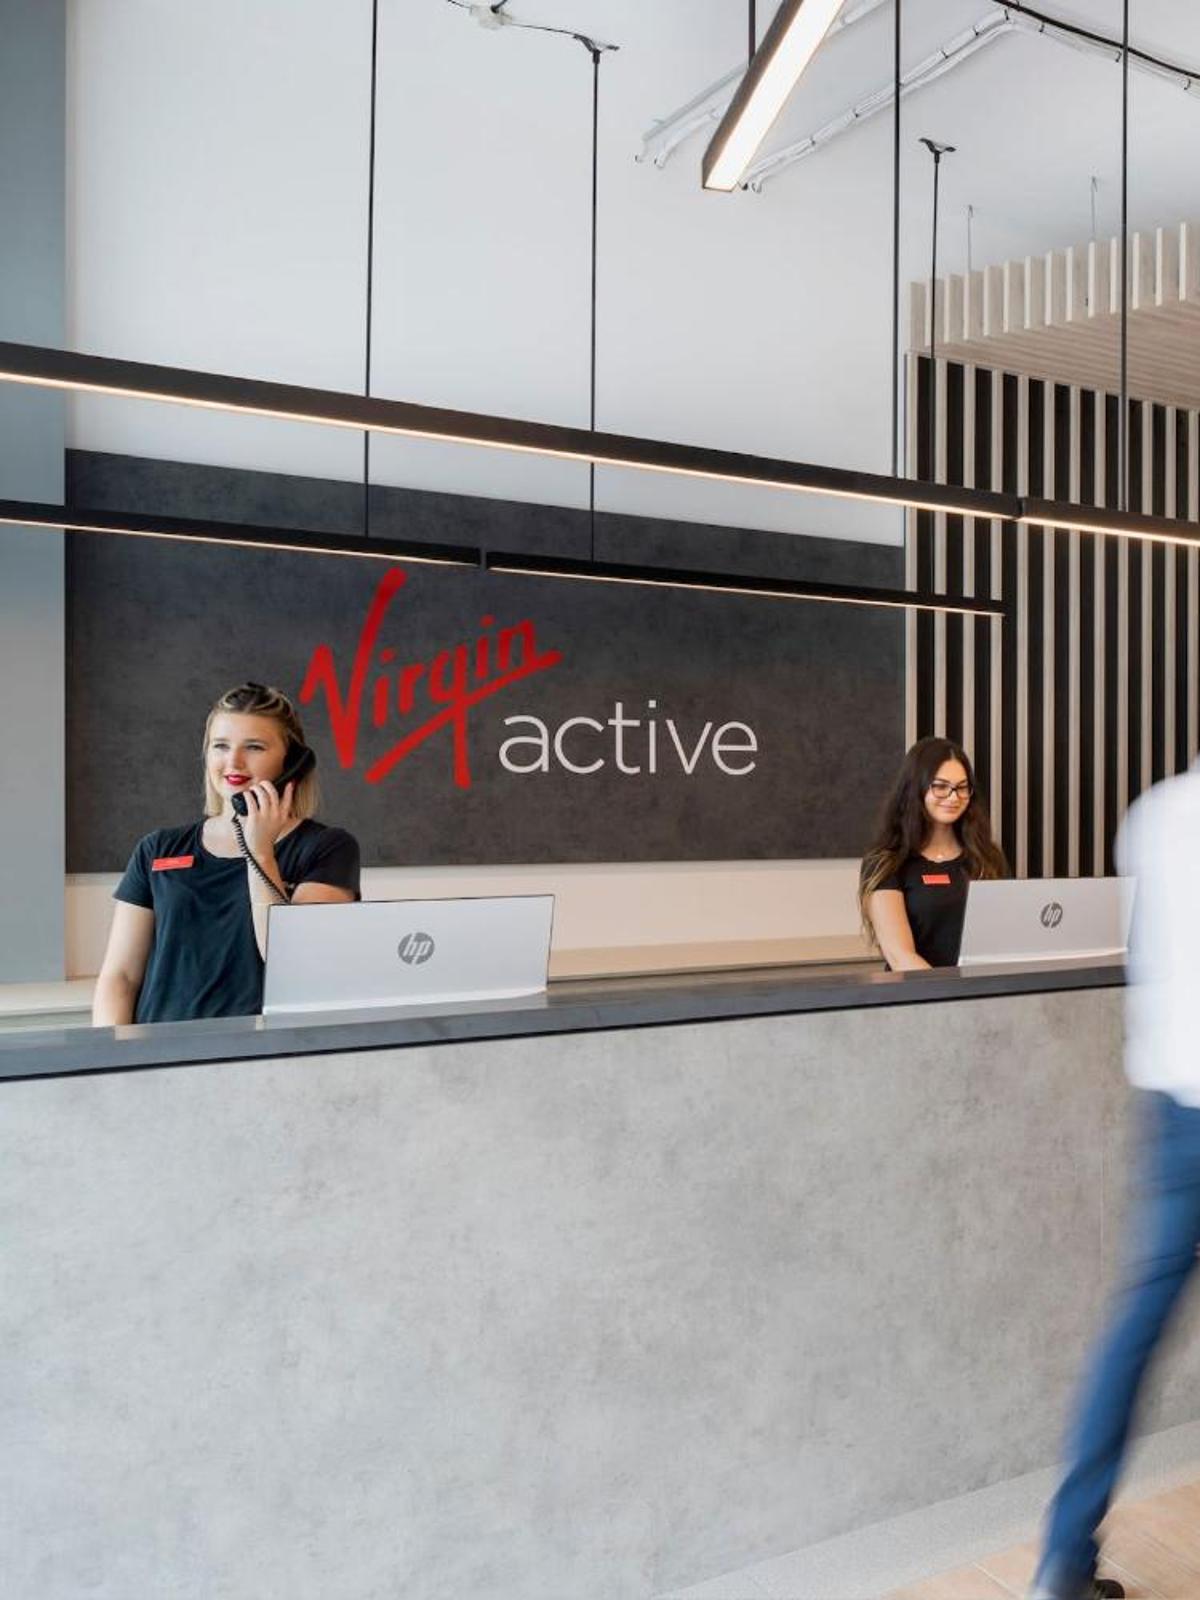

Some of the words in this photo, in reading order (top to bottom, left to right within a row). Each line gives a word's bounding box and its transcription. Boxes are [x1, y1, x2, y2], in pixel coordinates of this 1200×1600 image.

[300, 567, 562, 789] Virgin
[498, 700, 758, 776] active
[1041, 902, 1062, 928] hp
[400, 932, 433, 965] hp
